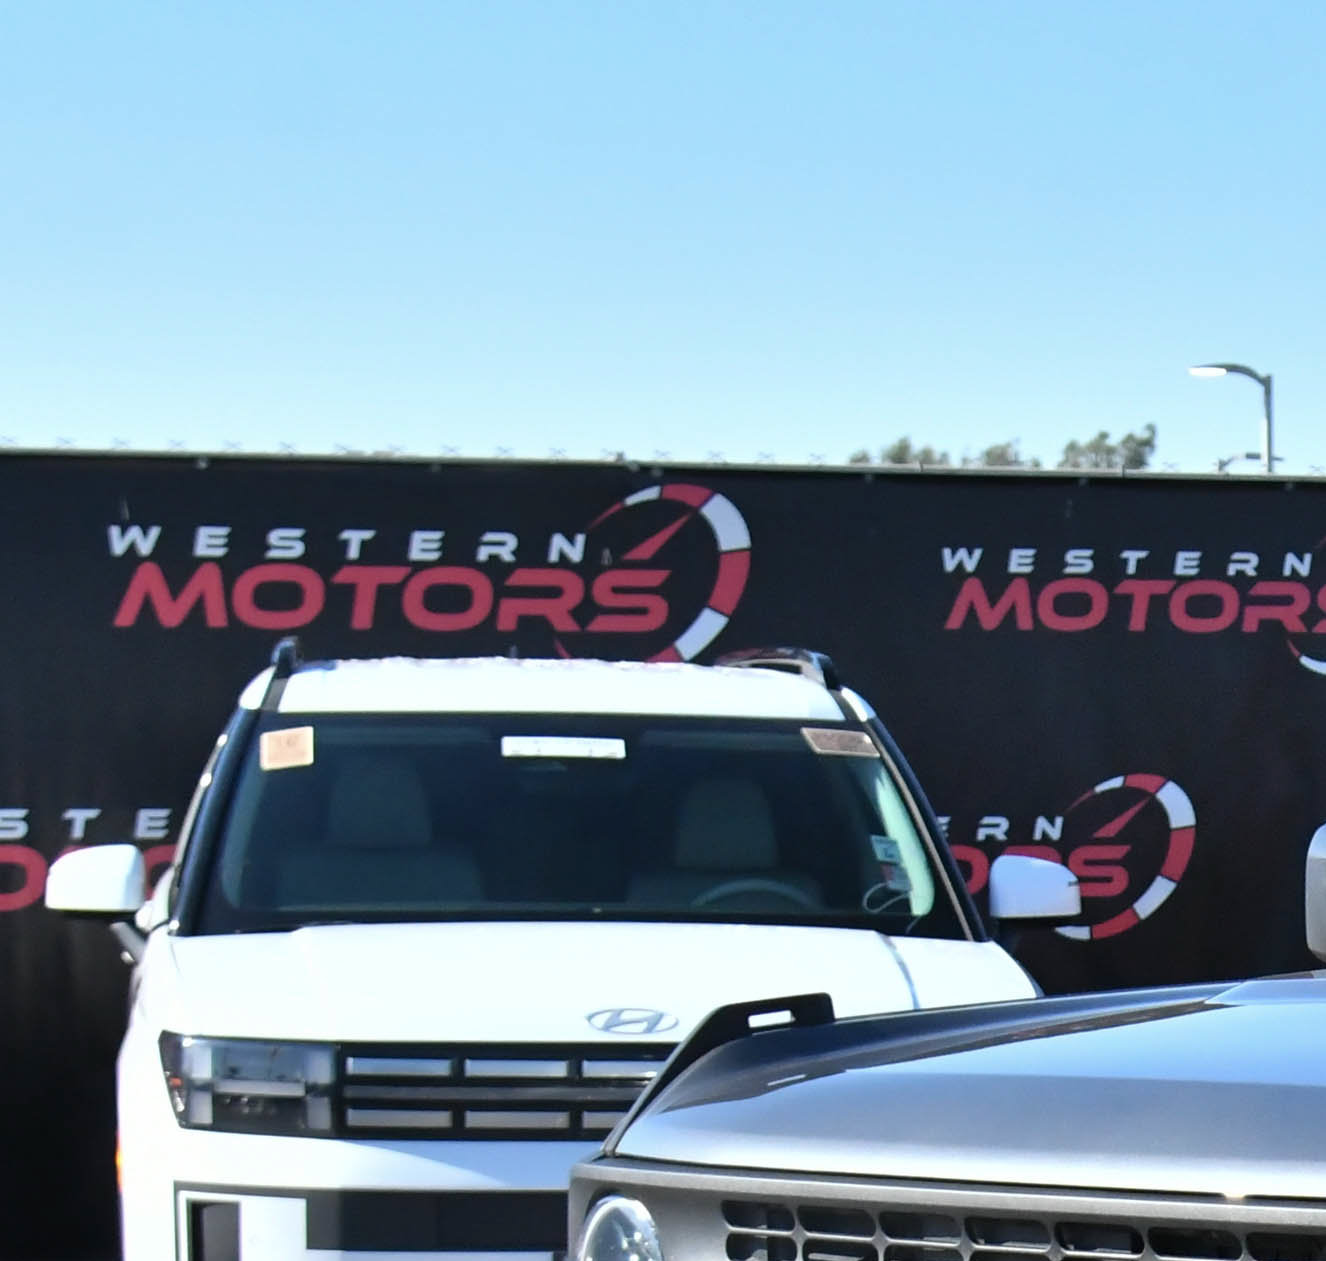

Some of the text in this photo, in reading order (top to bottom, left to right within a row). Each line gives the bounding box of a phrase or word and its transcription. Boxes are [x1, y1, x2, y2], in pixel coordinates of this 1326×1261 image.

[107, 524, 587, 563] WESTERN
[941, 547, 1313, 577] WESTERN
[113, 562, 673, 632] MOTORS
